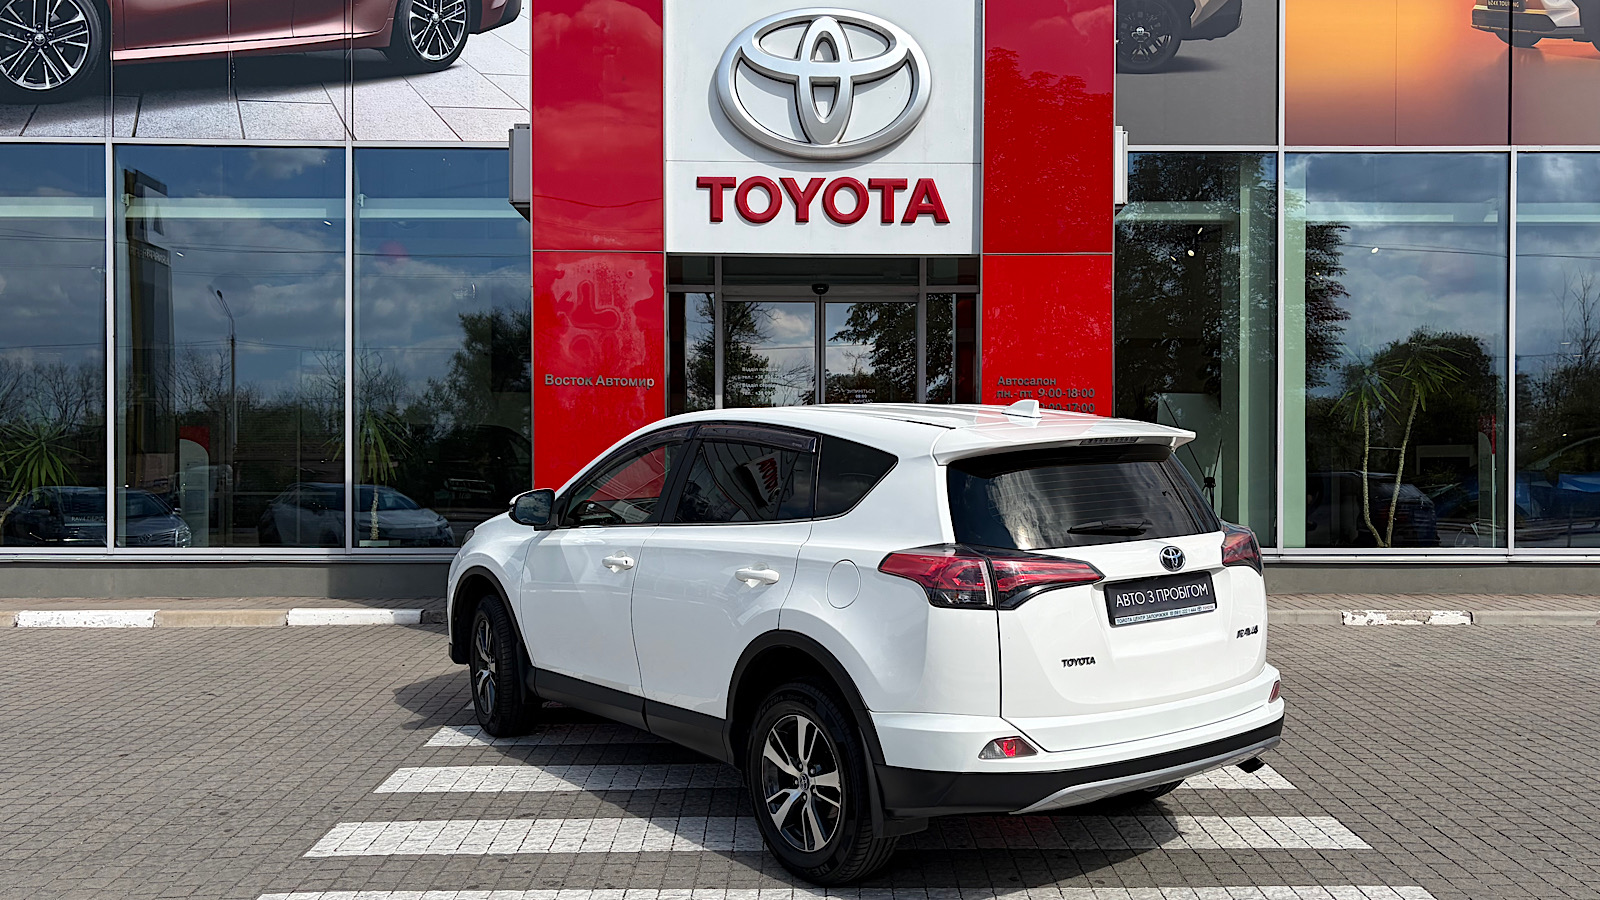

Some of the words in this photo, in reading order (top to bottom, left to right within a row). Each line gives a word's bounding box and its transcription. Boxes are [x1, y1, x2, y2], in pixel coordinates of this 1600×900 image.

[1499, 0, 1519, 8] TOURNG
[697, 175, 950, 225] TOYOTA
[545, 374, 593, 386] Восток
[595, 375, 655, 390] Автомир
[997, 375, 1057, 386] Автосалон
[1037, 388, 1095, 398] 9:00-18:00
[1116, 591, 1146, 608] АВТО
[1155, 583, 1209, 602] ПРОБІГОМ
[1061, 656, 1096, 668] TOYOTA
